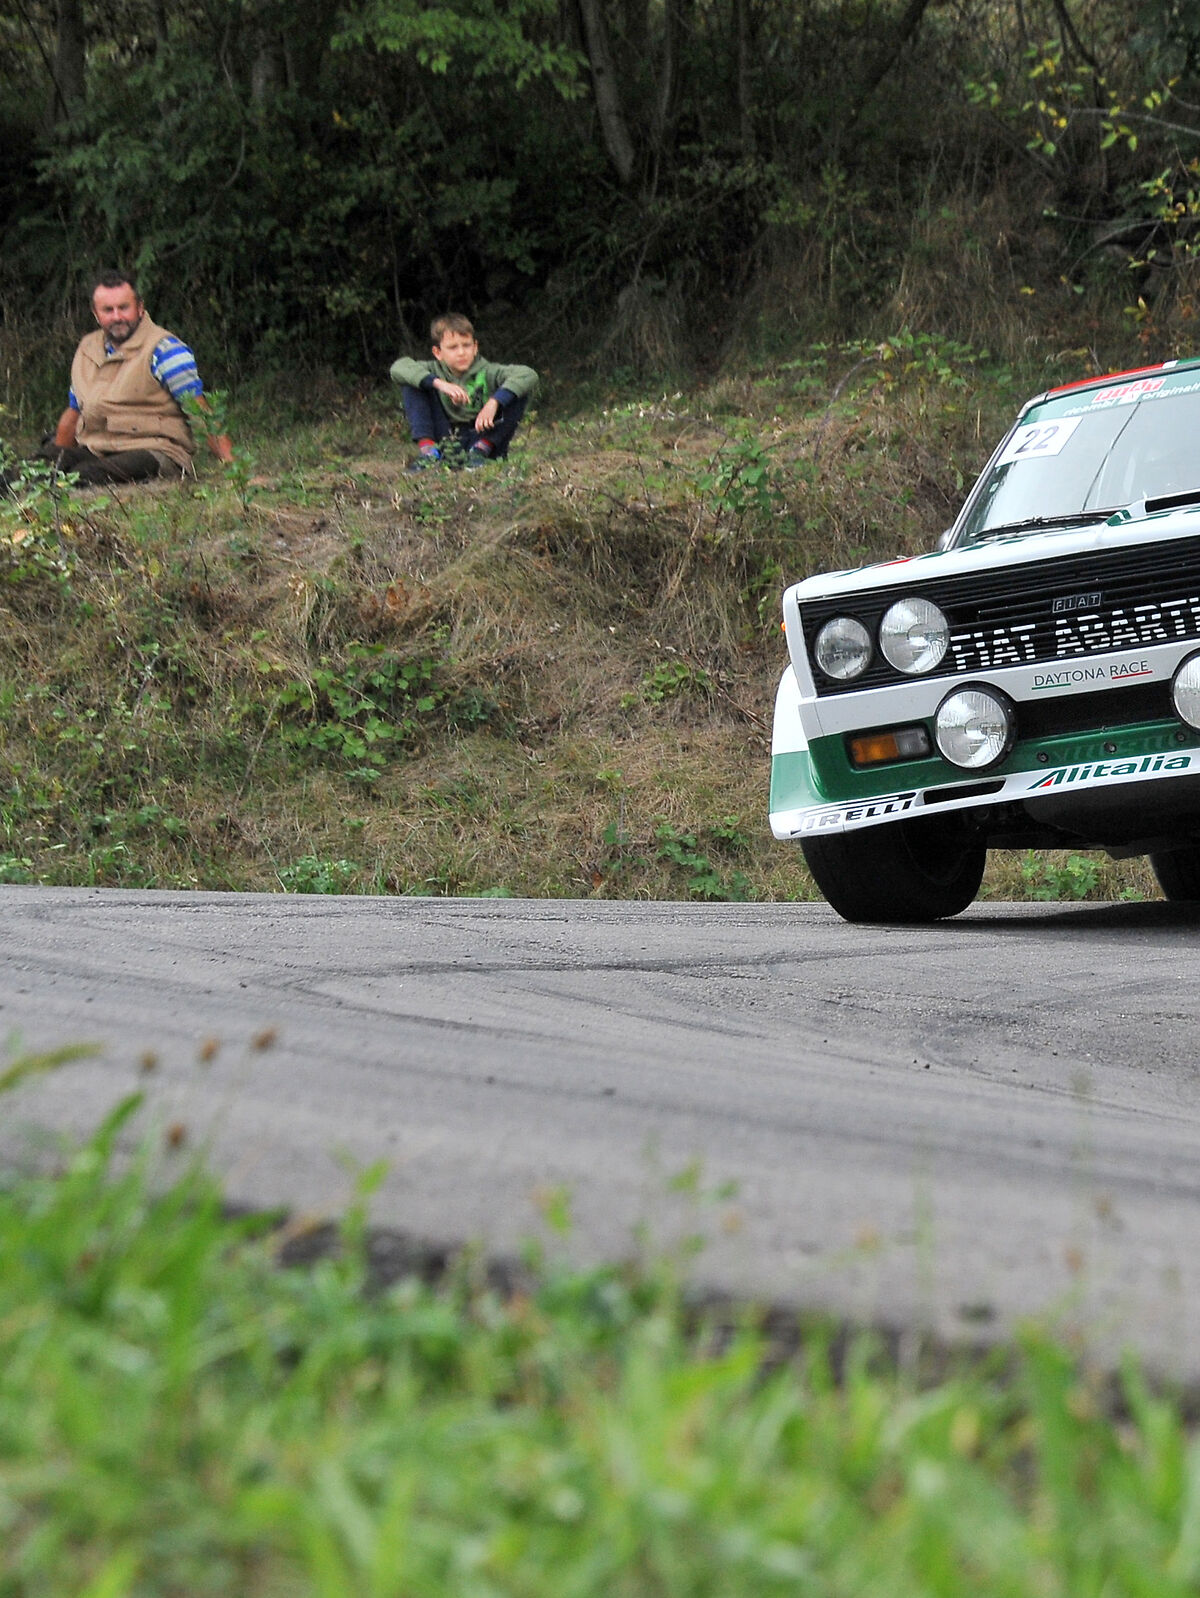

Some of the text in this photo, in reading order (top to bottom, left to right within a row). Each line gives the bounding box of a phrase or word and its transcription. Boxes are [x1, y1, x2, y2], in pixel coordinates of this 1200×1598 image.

[1092, 378, 1167, 403] FIAT
[1015, 425, 1060, 454] 22
[1055, 594, 1099, 612] FIAT
[950, 624, 1036, 670] FIAT
[1034, 660, 1149, 687] DAYTONA RACE
[1027, 755, 1192, 791] Alitalia
